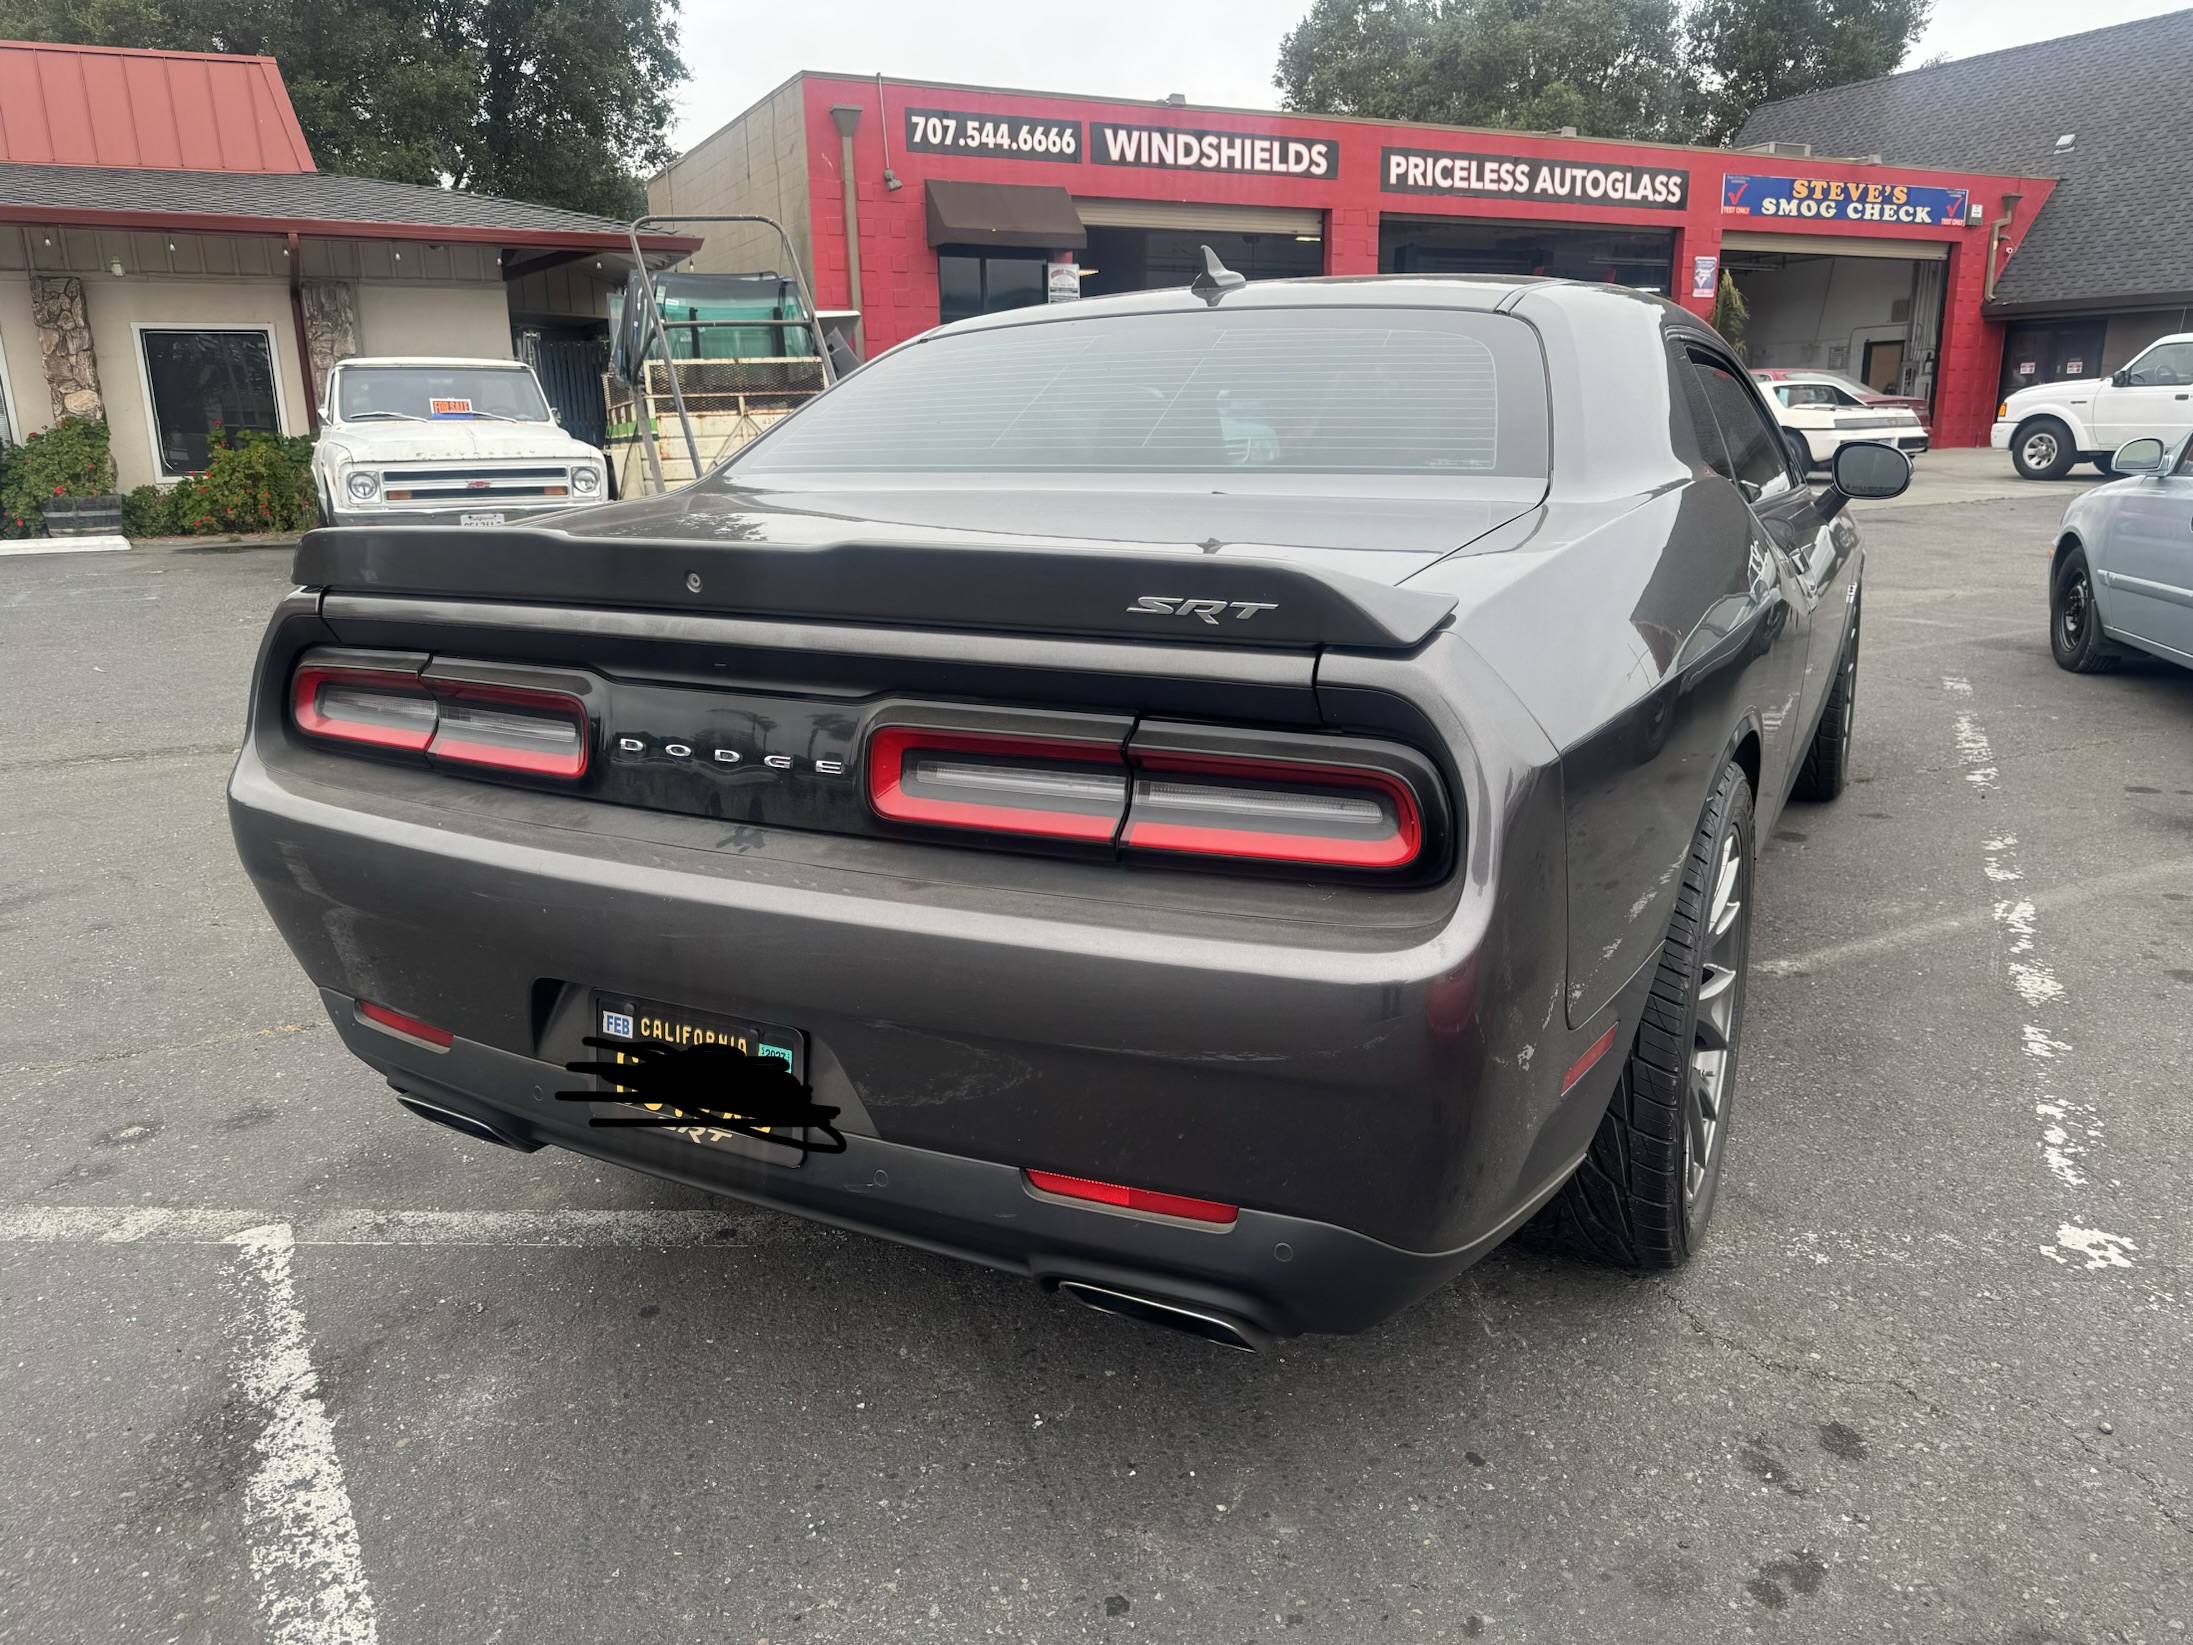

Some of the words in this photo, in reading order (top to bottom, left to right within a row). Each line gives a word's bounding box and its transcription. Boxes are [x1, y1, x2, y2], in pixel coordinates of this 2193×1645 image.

[911, 116, 1076, 154] 707.544.6666
[1104, 127, 1328, 175] WINDSHIELDS
[1389, 154, 1529, 193] PRICELESS
[1534, 166, 1682, 203] AUTOGLASS
[1792, 179, 1908, 204] STEVE'S
[1761, 198, 1837, 218] SMOG
[1846, 202, 1932, 223] CHECK
[433, 401, 449, 413] FOR
[450, 401, 469, 412] SALE
[1126, 596, 1279, 625] SRT
[619, 738, 844, 775] DODGE
[606, 1014, 630, 1036] FEB
